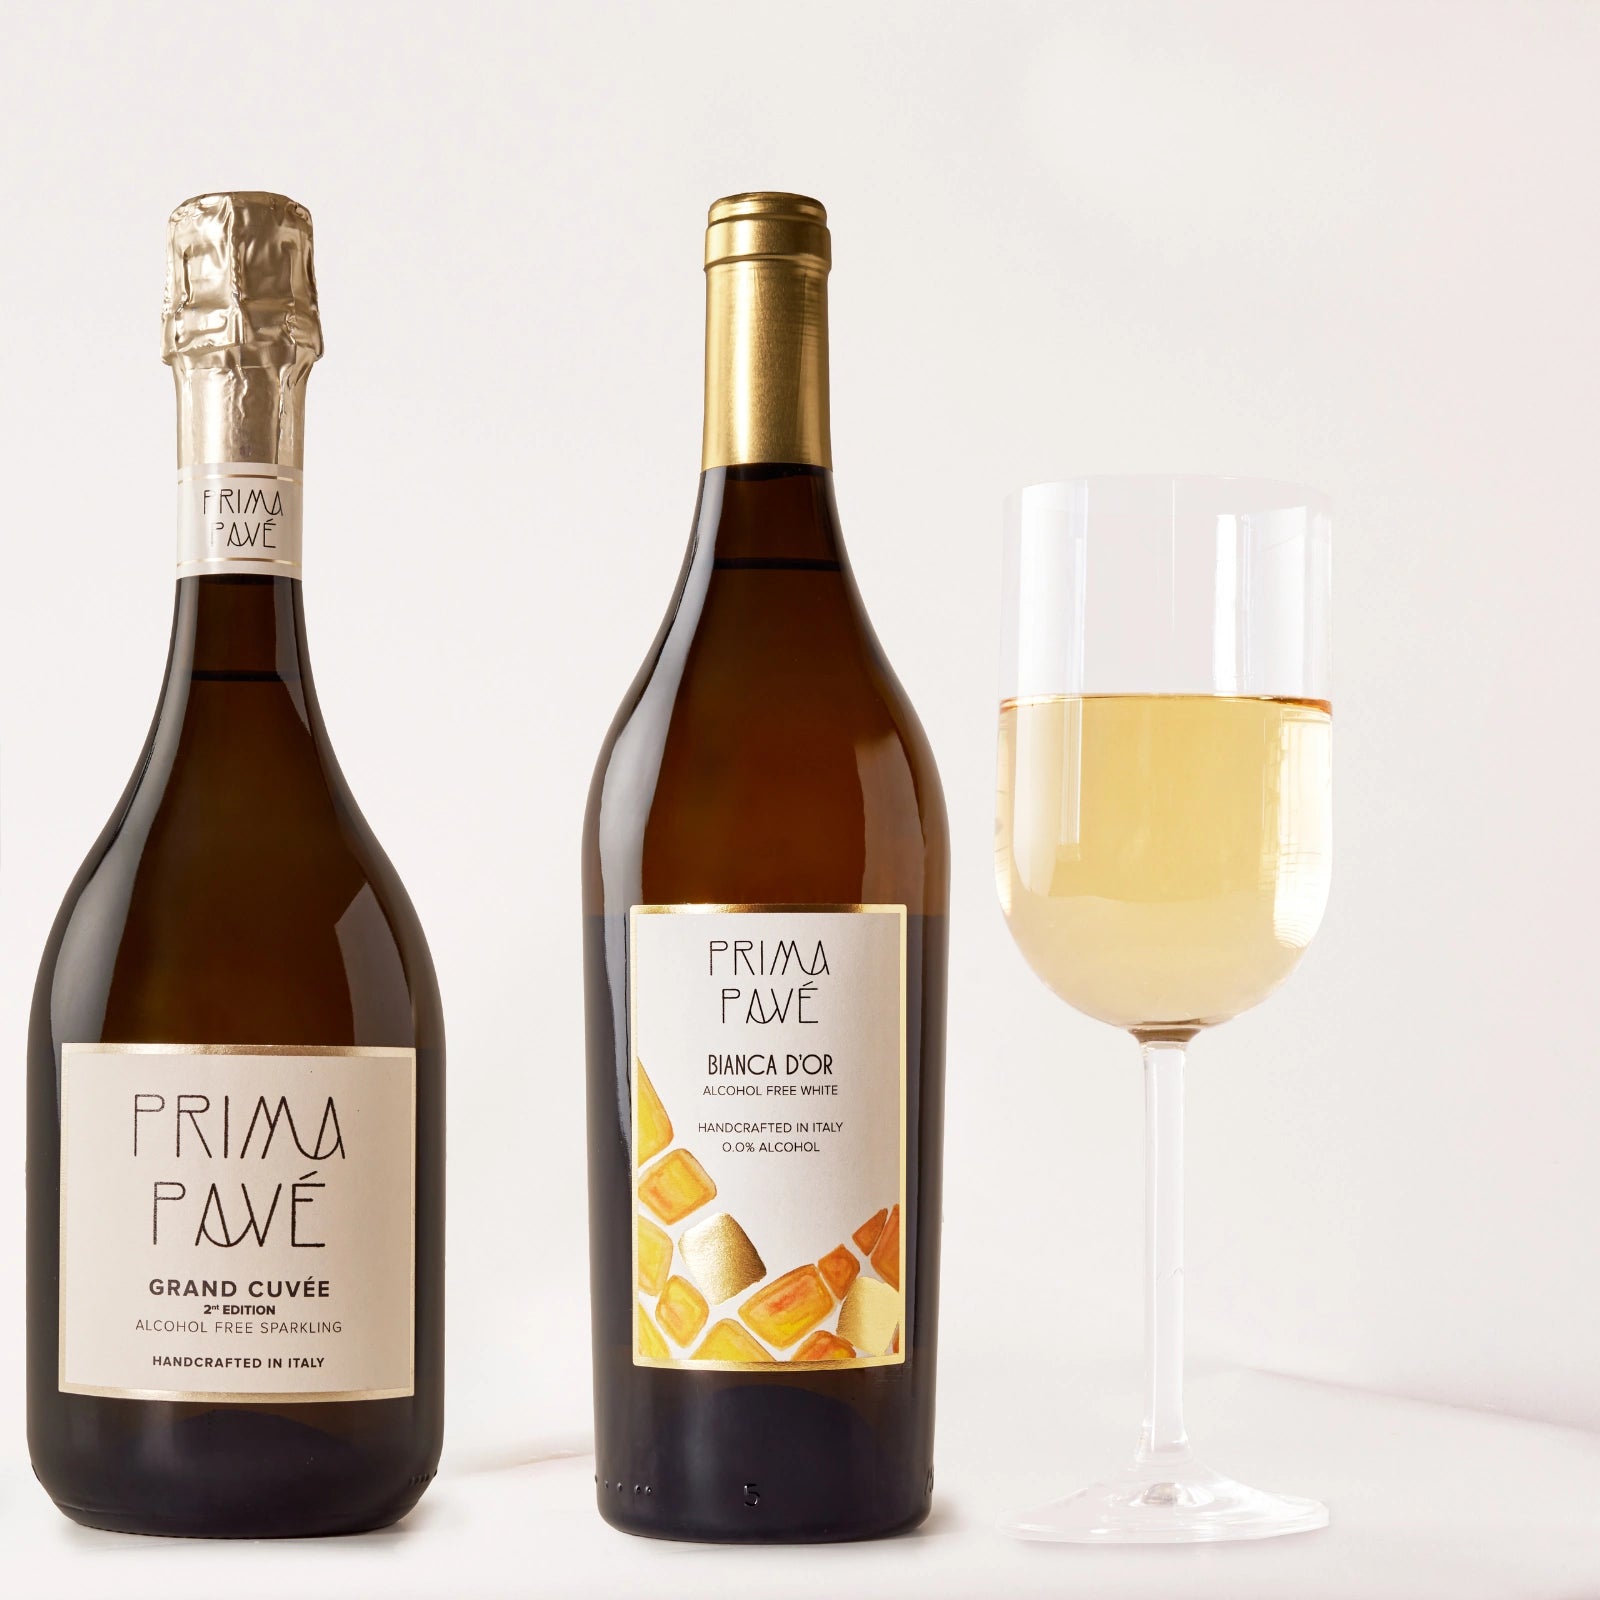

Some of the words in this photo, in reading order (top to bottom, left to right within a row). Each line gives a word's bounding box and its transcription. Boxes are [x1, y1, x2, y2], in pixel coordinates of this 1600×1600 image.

[203, 488, 284, 517] PRIMA
[210, 518, 277, 549] PAVÉ
[709, 940, 830, 976] PRIMA
[721, 981, 819, 1025] PAVÉ
[707, 1054, 778, 1076] BIANCA
[786, 1054, 834, 1076] D'OR
[702, 1085, 763, 1097] ALCOHOL
[766, 1085, 797, 1096] FREE
[800, 1085, 839, 1096] WHITE
[133, 1093, 346, 1160] PRIMA
[698, 1122, 793, 1134] HANDCRAFTED
[796, 1122, 809, 1133] IN
[812, 1121, 844, 1133] ITALY
[722, 1142, 756, 1153] 0.0%
[758, 1141, 820, 1153] ALCOHOL
[152, 1171, 327, 1248] PAVÉ
[148, 1278, 238, 1298] GRAND
[247, 1275, 330, 1299] CUVÉE
[222, 1304, 276, 1316] EDITION
[135, 1319, 209, 1335] ALCOHOL
[214, 1320, 254, 1335] FREE
[259, 1320, 343, 1335] SPARKLING
[152, 1355, 263, 1369] HANDCRAFTED
[267, 1357, 283, 1369] IN
[287, 1356, 325, 1369] ITALY
[743, 1482, 760, 1506] 5
